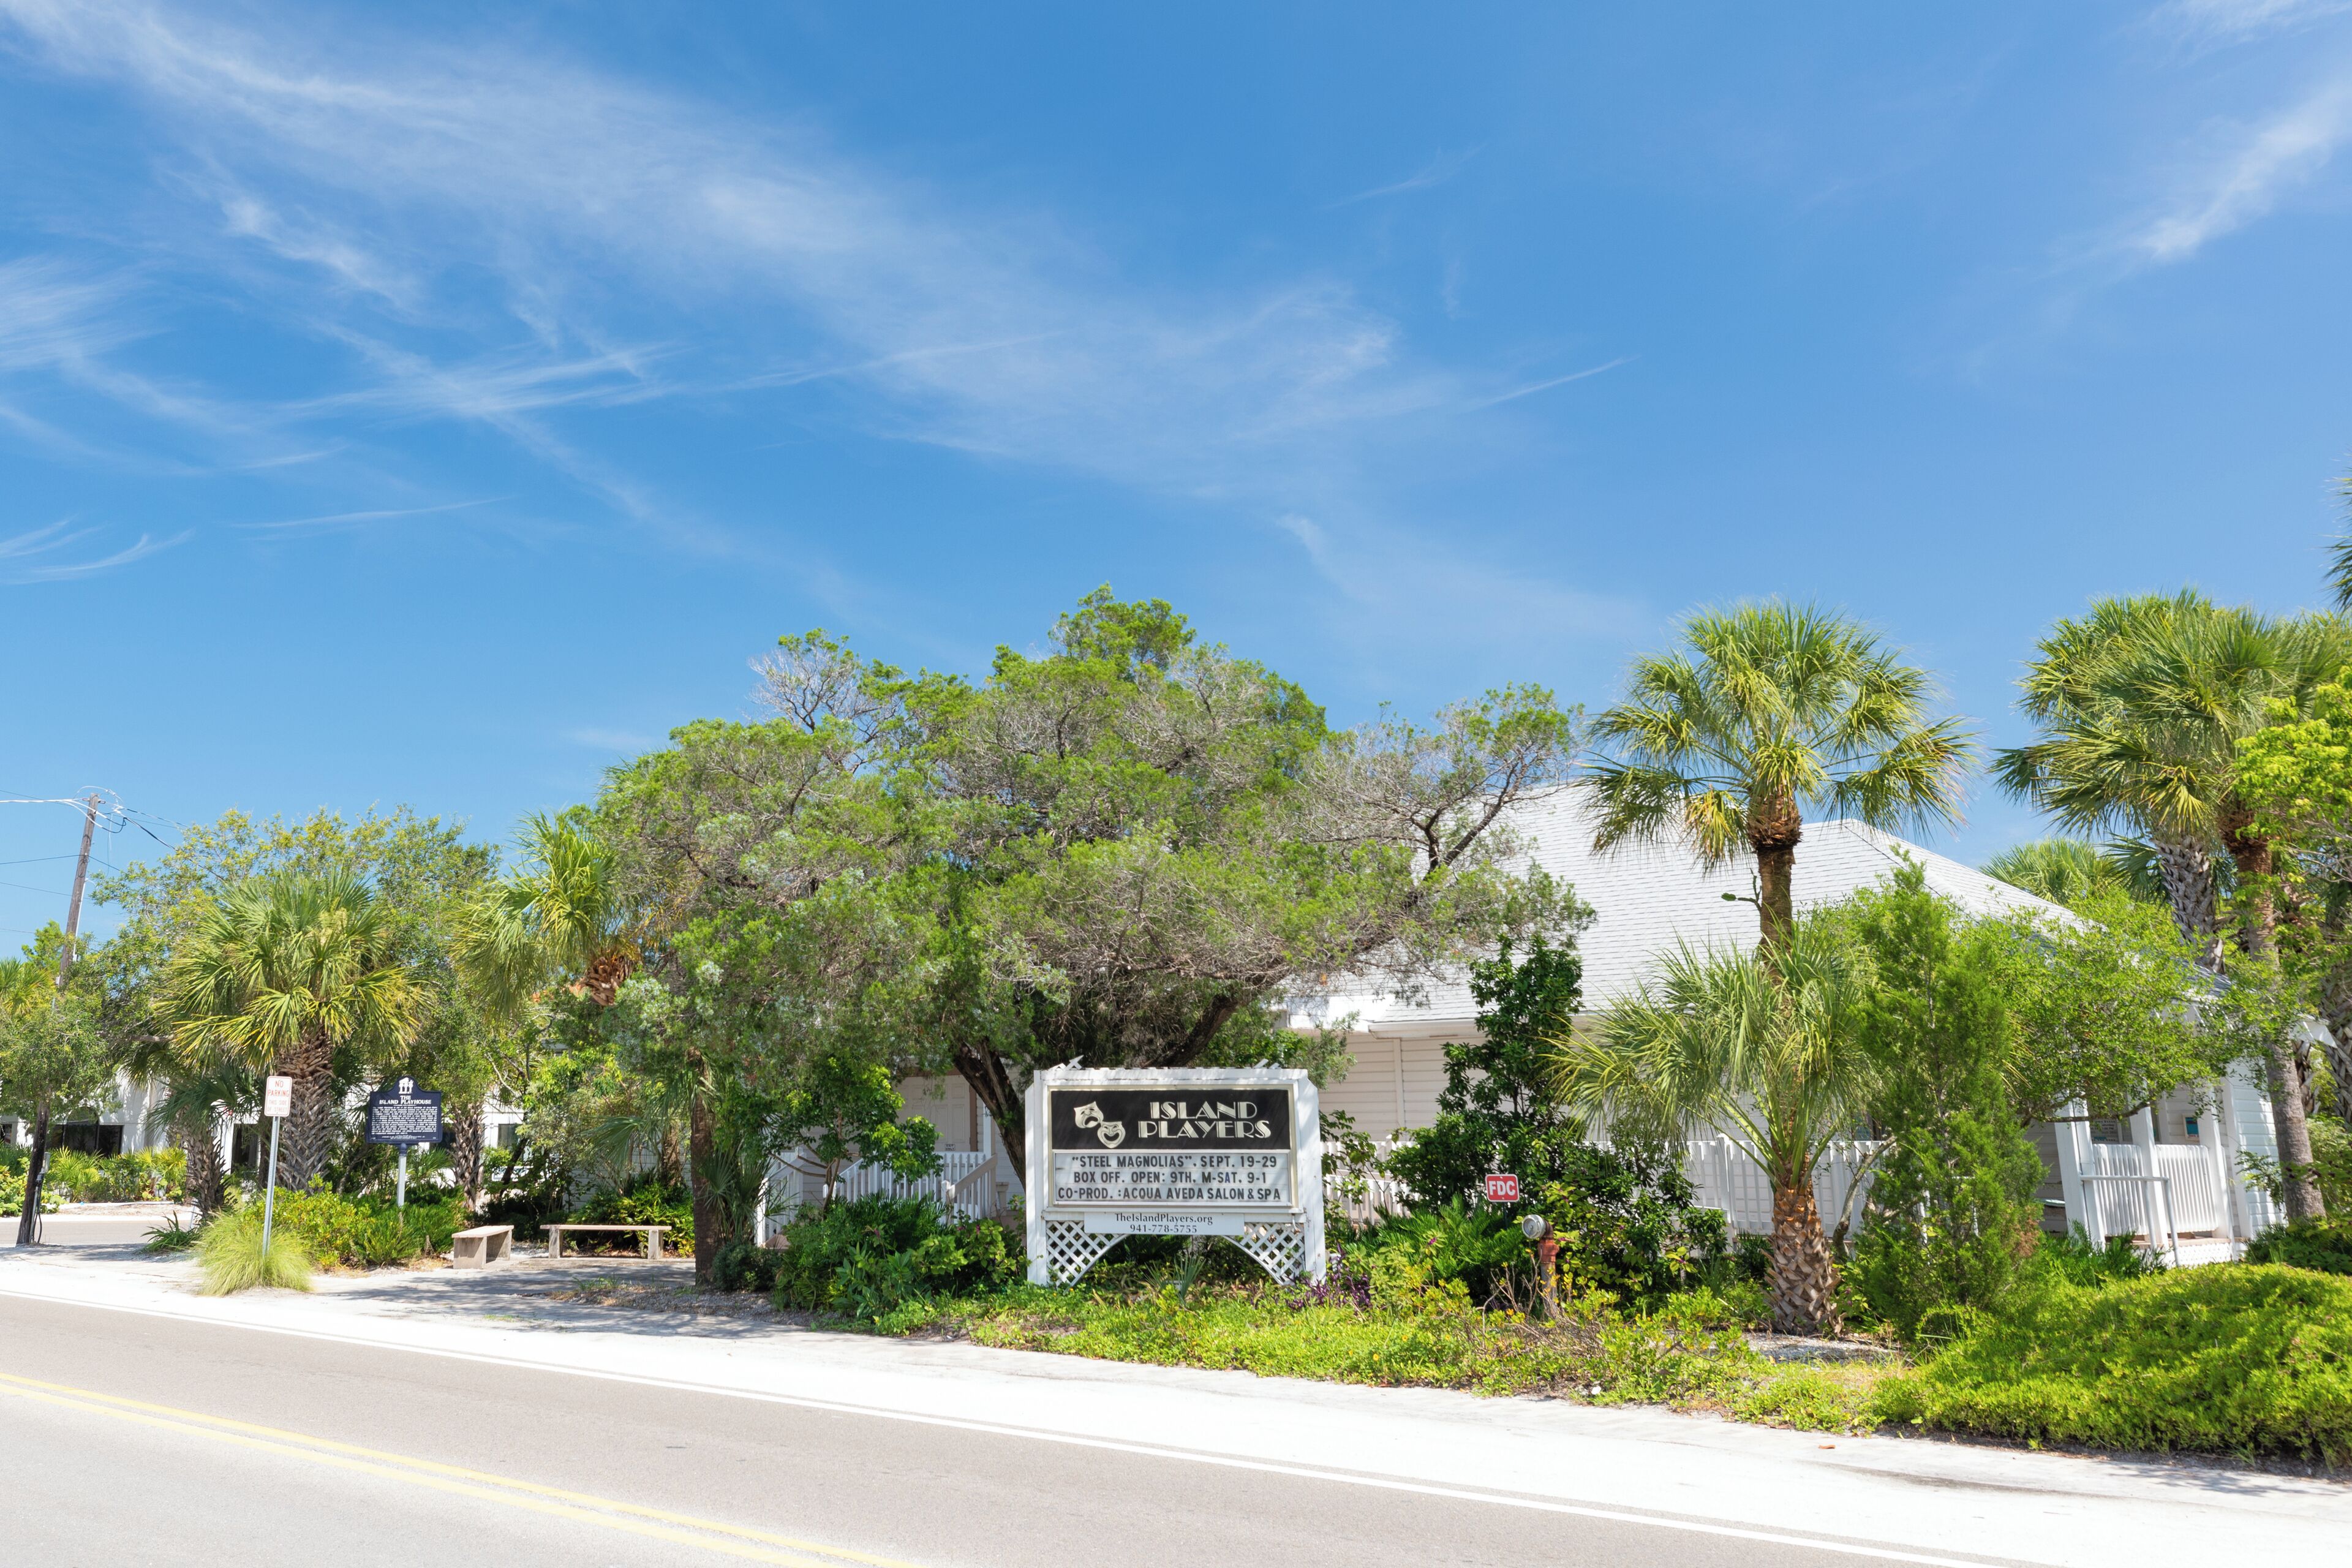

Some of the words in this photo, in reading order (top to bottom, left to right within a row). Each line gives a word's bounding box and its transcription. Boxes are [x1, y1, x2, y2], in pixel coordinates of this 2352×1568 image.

[1150, 1101, 1257, 1119] ISLAND
[1138, 1120, 1271, 1138] PLAYERS
[1200, 1156, 1235, 1167] SEPT.
[1240, 1156, 1276, 1167] 19-29
[1074, 1172, 1095, 1183] BOX
[1101, 1172, 1125, 1183] OFF.
[1131, 1172, 1165, 1183] OPEN:
[1247, 1172, 1266, 1183] 9-1
[1166, 1188, 1204, 1199] AVEDA
[1207, 1188, 1245, 1199] SALON
[1247, 1188, 1254, 1199] &
[1257, 1188, 1281, 1200] SPA
[1488, 1180, 1516, 1196] FDC
[1115, 1213, 1213, 1226] TheIslandPlayers.org
[1130, 1224, 1197, 1234] 941-778-5755
